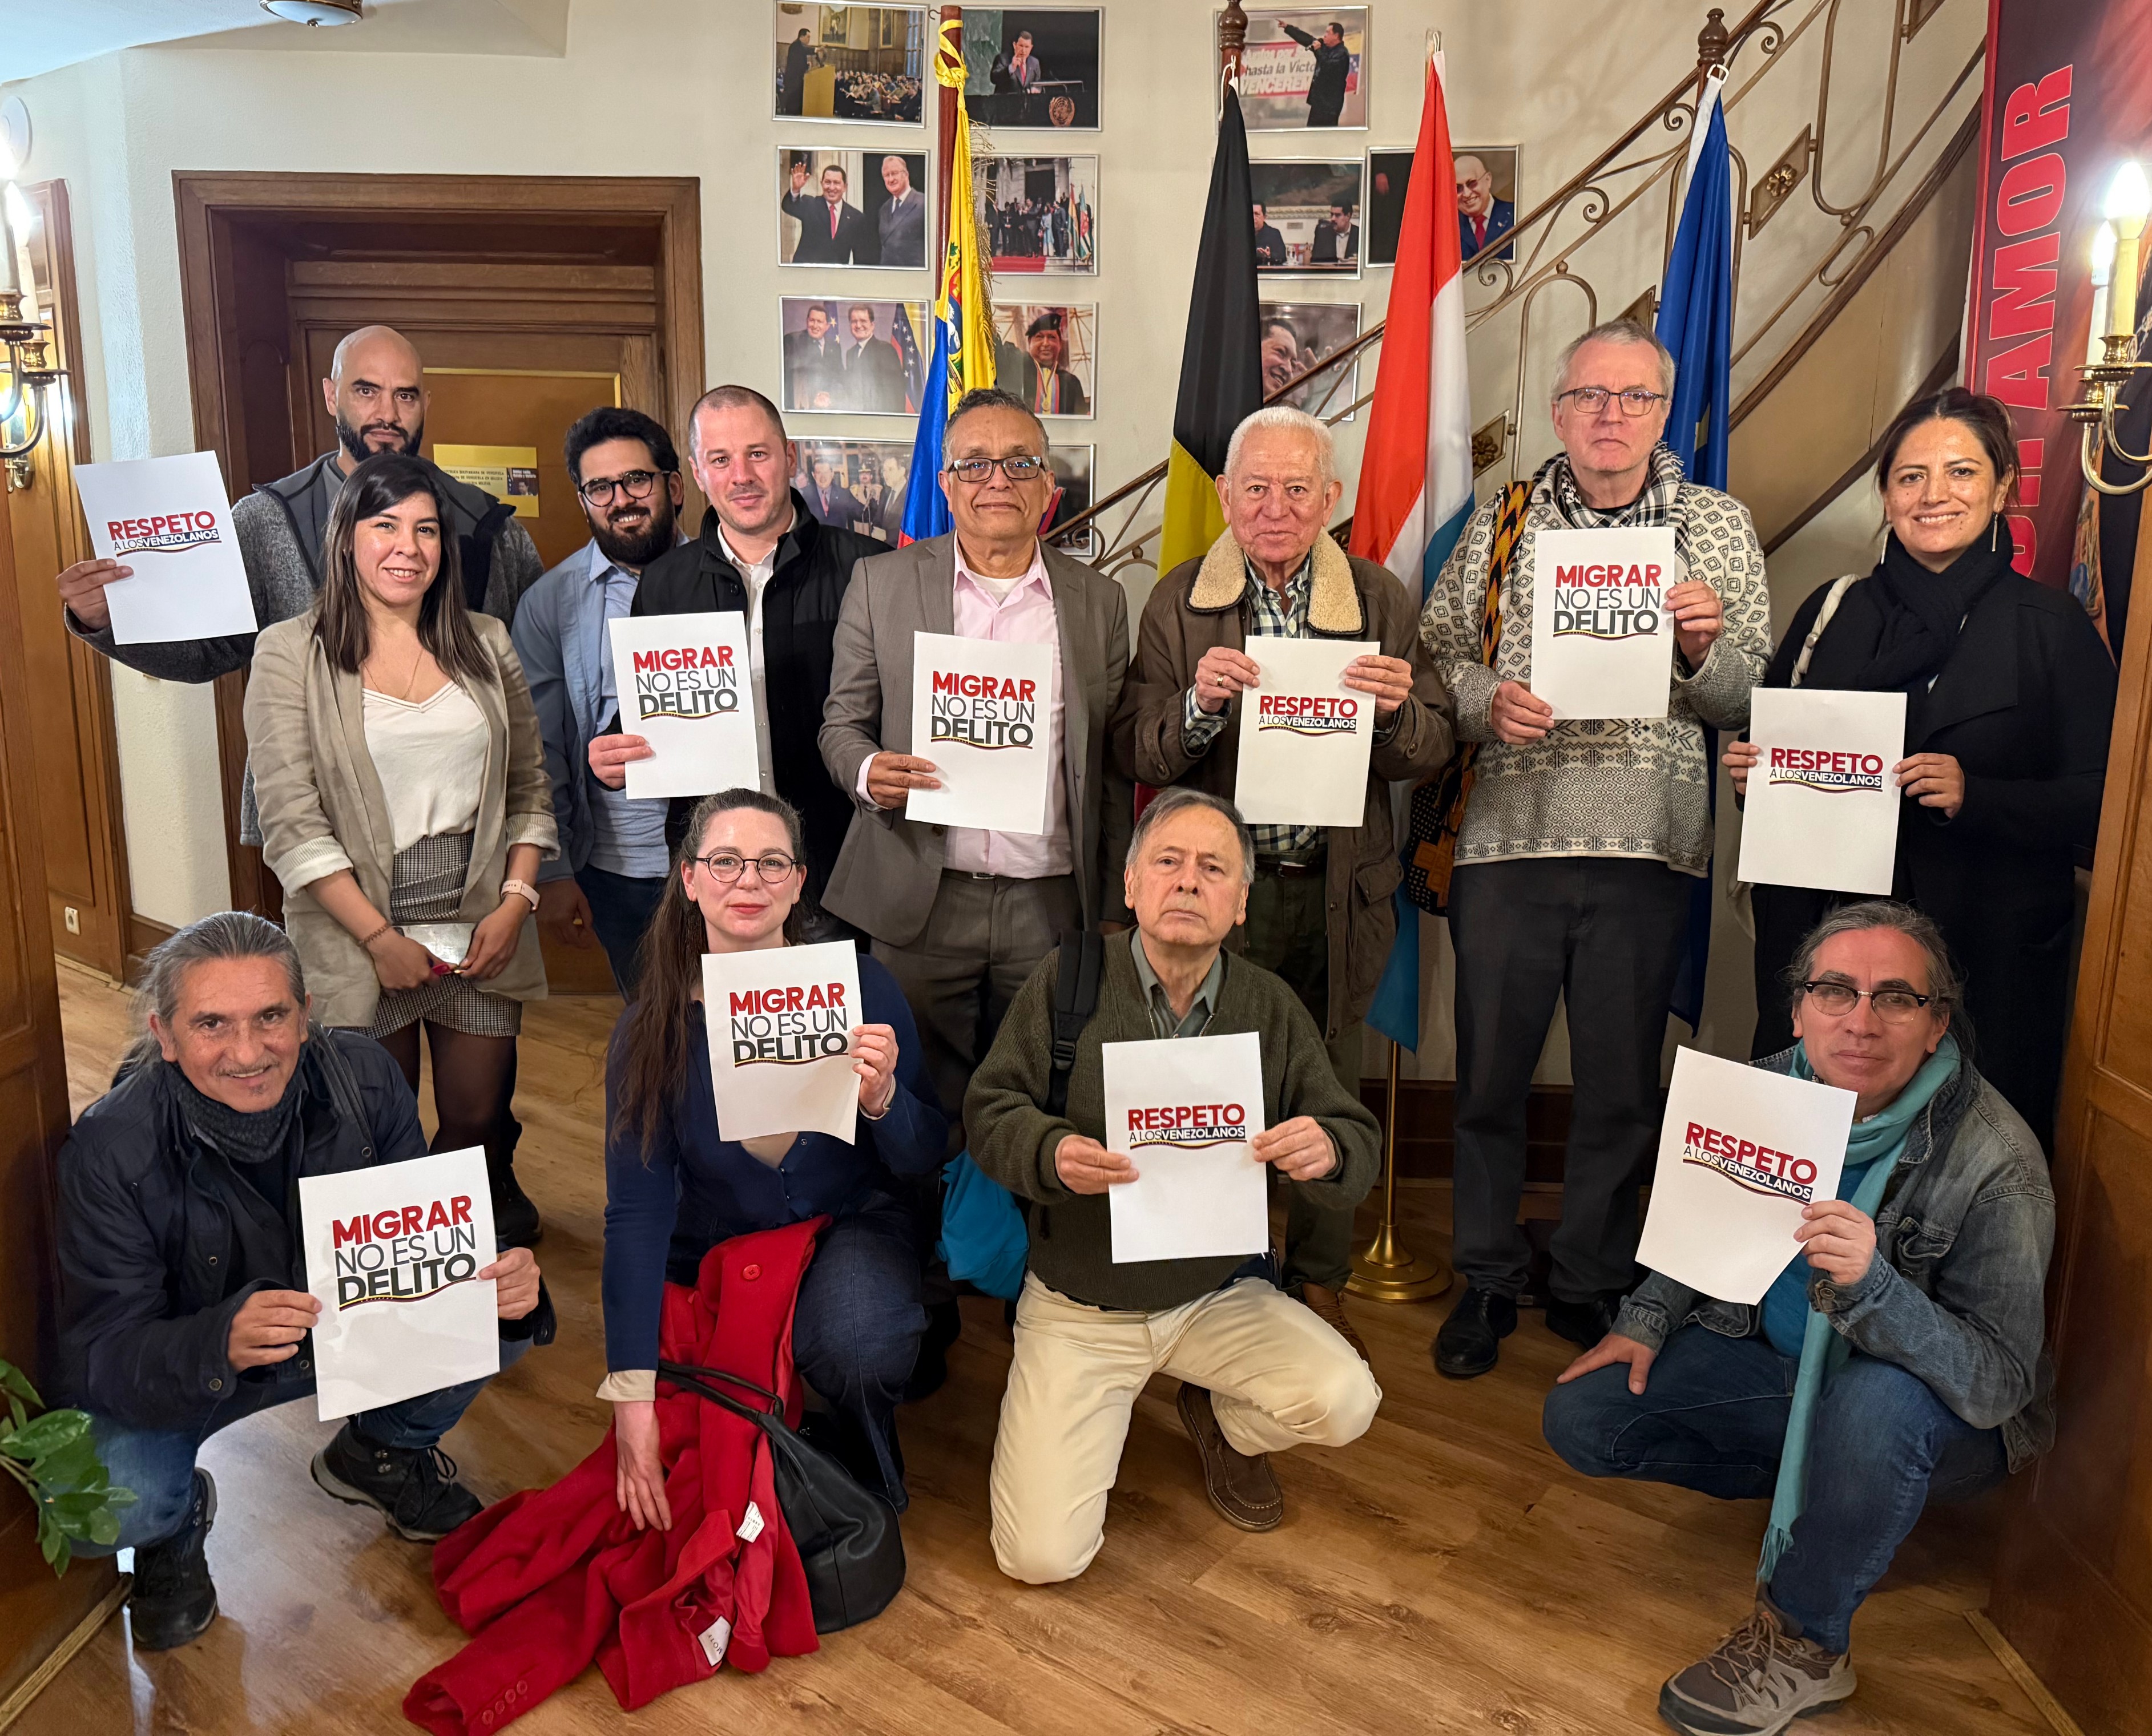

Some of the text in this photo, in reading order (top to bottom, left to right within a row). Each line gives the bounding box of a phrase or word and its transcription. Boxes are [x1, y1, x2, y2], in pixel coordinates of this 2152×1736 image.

[1289, 59, 1315, 72] Victo
[1986, 64, 2073, 410] AMOR
[107, 511, 215, 541] RESPETO
[114, 541, 121, 551] A
[143, 530, 219, 547] VENEZOLANOS
[1555, 564, 1662, 588] MIGRAR
[1554, 588, 1661, 609] NO ES UN
[1554, 609, 1658, 635] DELITO
[632, 645, 734, 673] MIGRAR
[636, 667, 736, 694] NO ES UN
[932, 671, 1036, 703] MIGRAR
[638, 688, 738, 716] DELITO
[932, 694, 1035, 724] NO ES UN
[1259, 695, 1358, 718] RESPETO
[931, 716, 1033, 745] DELITO
[1259, 716, 1265, 725] A
[1286, 717, 1356, 729] VENEZOLANOS
[1770, 748, 1883, 775] RESPETO
[1770, 768, 1776, 778] A
[1800, 772, 1881, 786] VENEZOLANOS
[730, 982, 845, 1016] MIGRAR
[731, 1007, 848, 1040] NO ES UN
[733, 1032, 848, 1064] DELITO
[1128, 1103, 1245, 1131] RESPETO
[1129, 1132, 1137, 1142] A
[1162, 1127, 1244, 1140] VENEZOLANOS
[1685, 1121, 1817, 1185] RESPETO
[1683, 1145, 1692, 1157] A
[1719, 1156, 1812, 1200] VENEZOLANOS
[332, 1195, 473, 1249] MIGRAR
[335, 1223, 476, 1277] NO ES UN
[337, 1253, 476, 1306] DELITO
